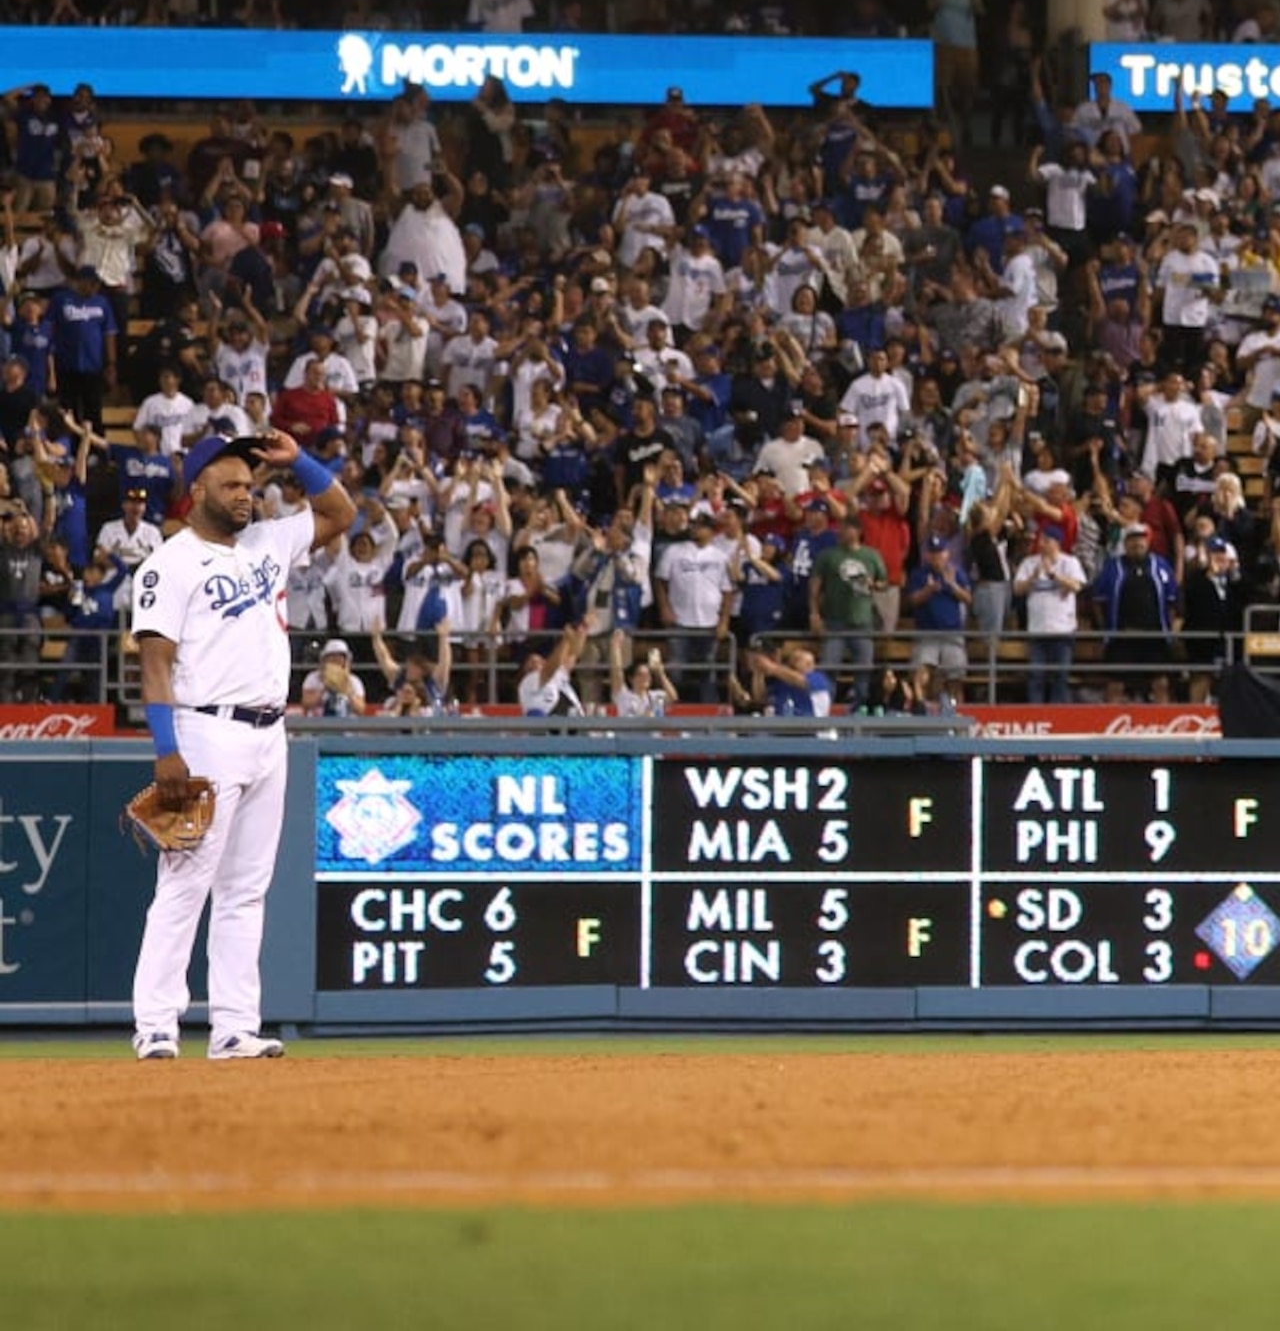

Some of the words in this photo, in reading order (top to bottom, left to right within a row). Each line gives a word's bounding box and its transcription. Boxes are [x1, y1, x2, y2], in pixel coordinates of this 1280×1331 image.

[382, 45, 575, 89] MORTON
[498, 776, 565, 814] NL
[684, 767, 808, 810] WSH
[817, 767, 848, 811] 2
[1014, 767, 1104, 811] ATL
[1150, 768, 1171, 811] 1
[909, 798, 933, 838] F
[1235, 798, 1259, 838] F
[432, 823, 629, 862] SCORES
[688, 820, 790, 861] MIA
[818, 820, 849, 861] 5
[1017, 820, 1098, 862] PHI
[1144, 820, 1175, 862] 9
[351, 889, 463, 931] CHC
[484, 886, 517, 931] 6
[687, 888, 774, 931] MIL
[818, 888, 849, 931] 5
[1017, 888, 1082, 931] SD
[1144, 888, 1173, 931] 3
[577, 918, 602, 957] F
[908, 918, 933, 957] F
[1220, 919, 1271, 957] 10
[353, 941, 426, 983] PIT
[486, 941, 516, 983] 5
[684, 940, 780, 982] CIN
[816, 940, 846, 982] 3
[1014, 940, 1120, 982] COL
[1143, 940, 1173, 982] 3
